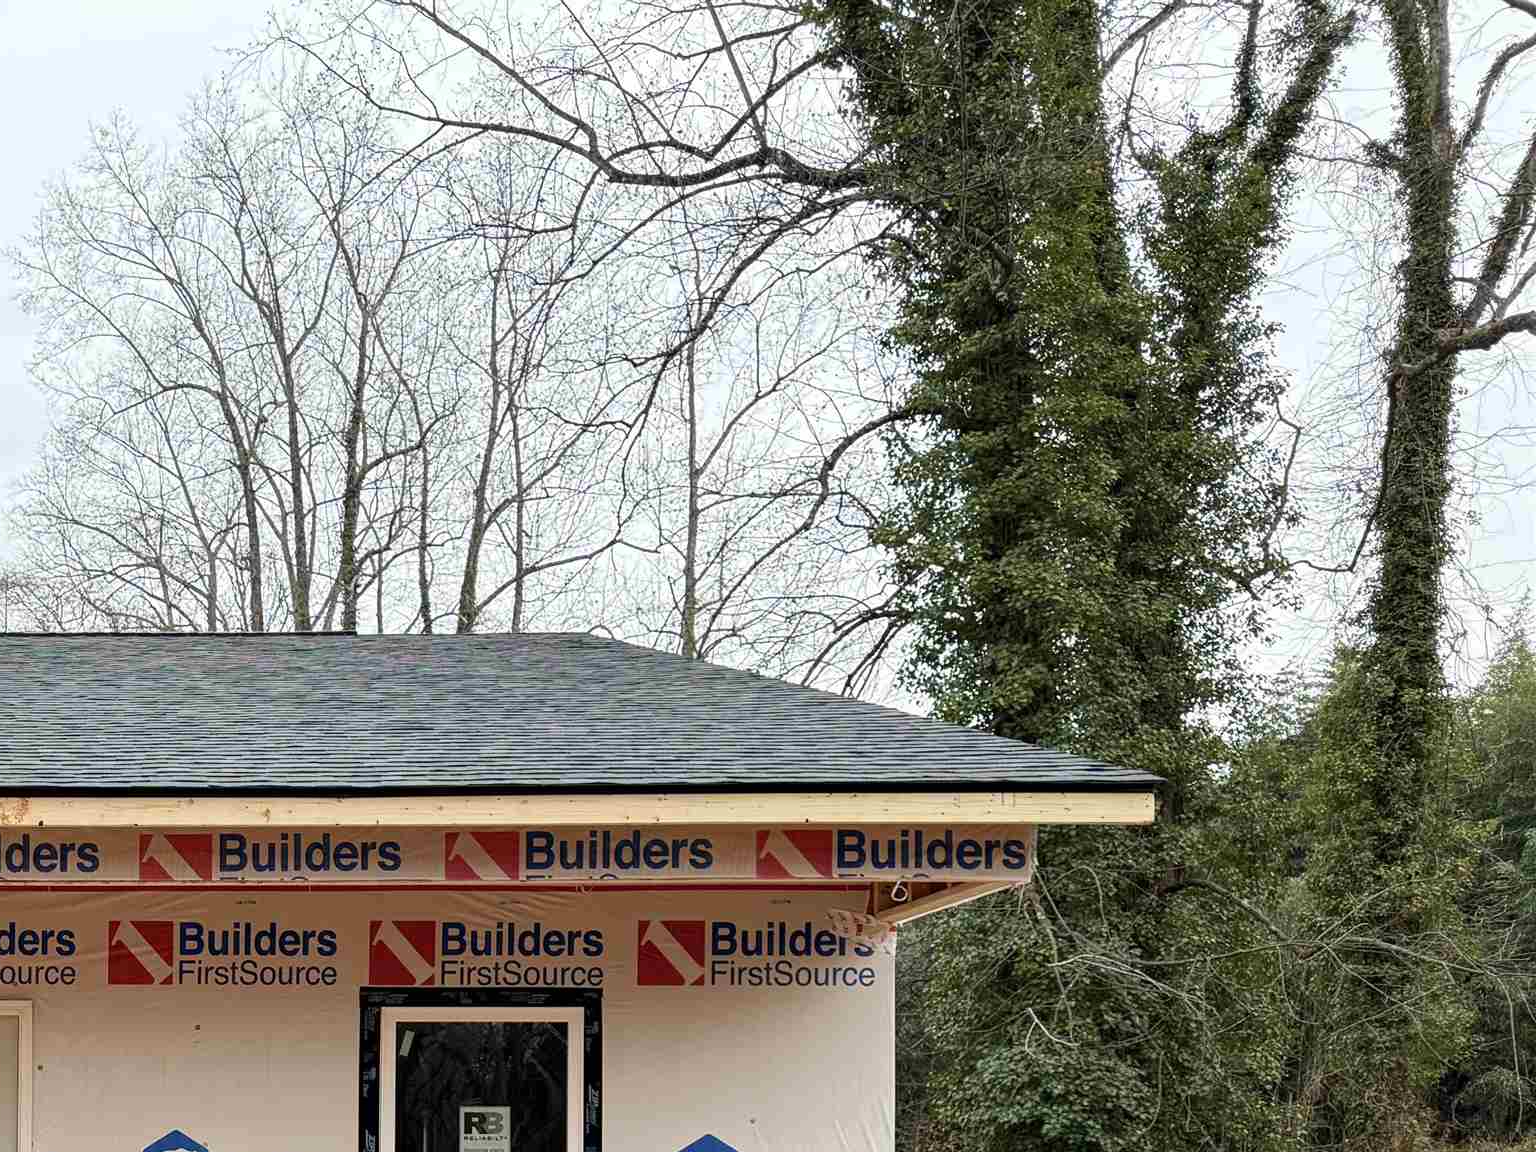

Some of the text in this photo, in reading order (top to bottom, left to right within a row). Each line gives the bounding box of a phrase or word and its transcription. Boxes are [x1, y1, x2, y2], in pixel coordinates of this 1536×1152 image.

[219, 833, 401, 871] Builders
[526, 831, 713, 869] Builders
[837, 831, 1025, 869] Builders
[178, 922, 337, 957] Builders
[441, 921, 603, 957] Builders
[178, 960, 337, 986] FirstSource
[441, 961, 603, 986] FirstSource
[711, 960, 875, 986] FirstSource
